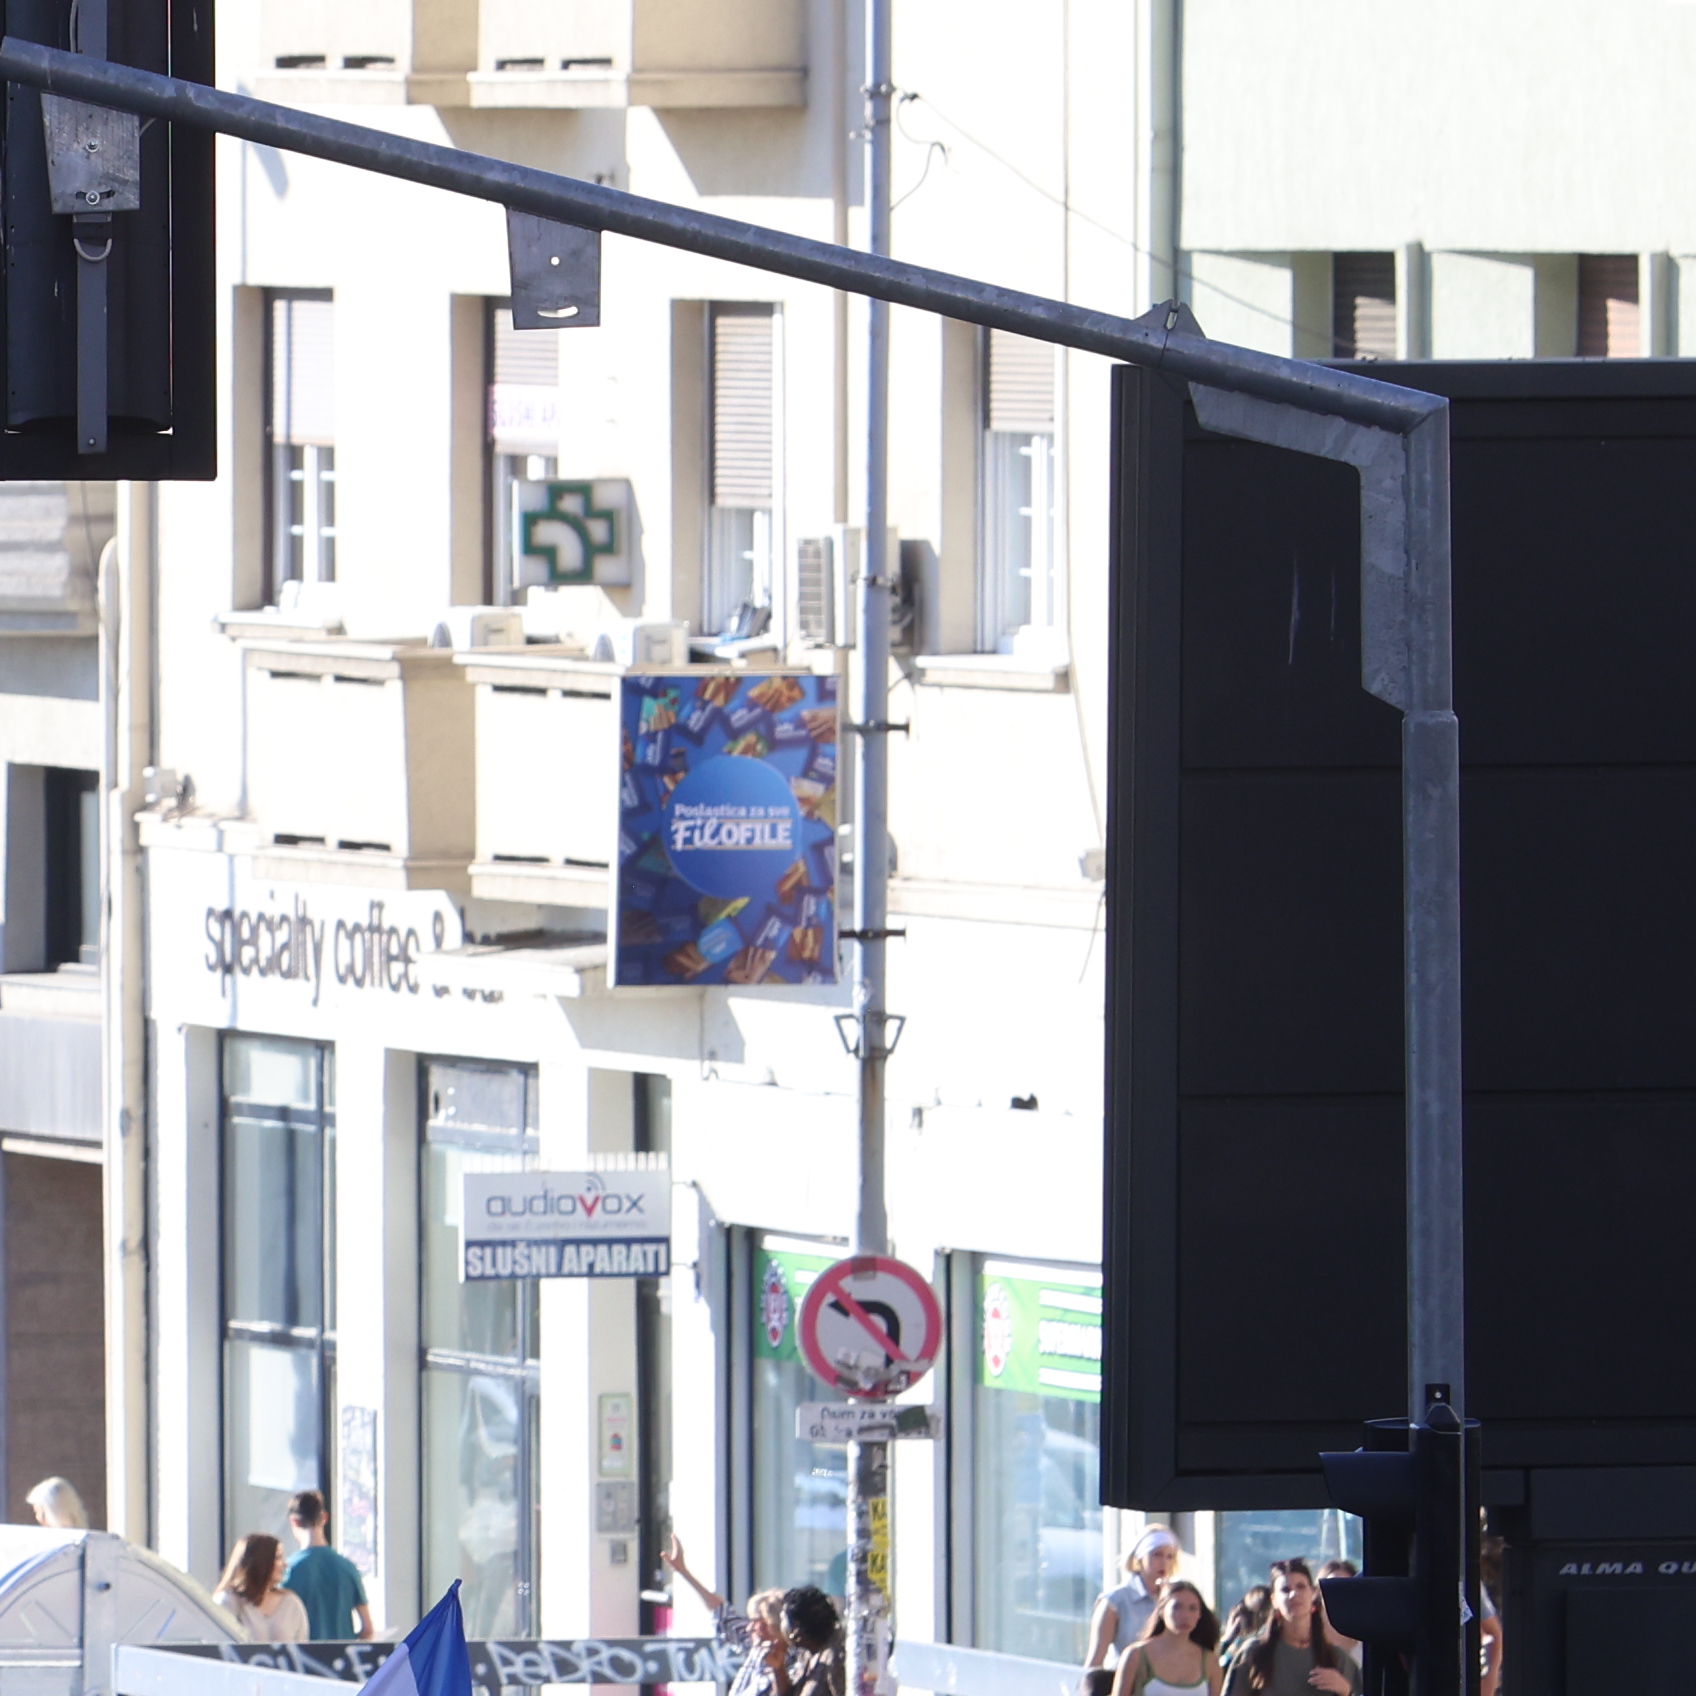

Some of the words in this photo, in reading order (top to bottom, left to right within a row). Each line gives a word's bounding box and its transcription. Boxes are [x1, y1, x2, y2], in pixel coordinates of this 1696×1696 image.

[674, 802, 745, 817] Poslastica
[748, 805, 766, 817] za
[205, 889, 326, 1008] specialty
[485, 1184, 646, 1218] audiovox
[466, 1240, 558, 1277] SLUŠNI
[560, 1242, 669, 1275] APARATI
[1559, 1561, 1645, 1575] ALMA
